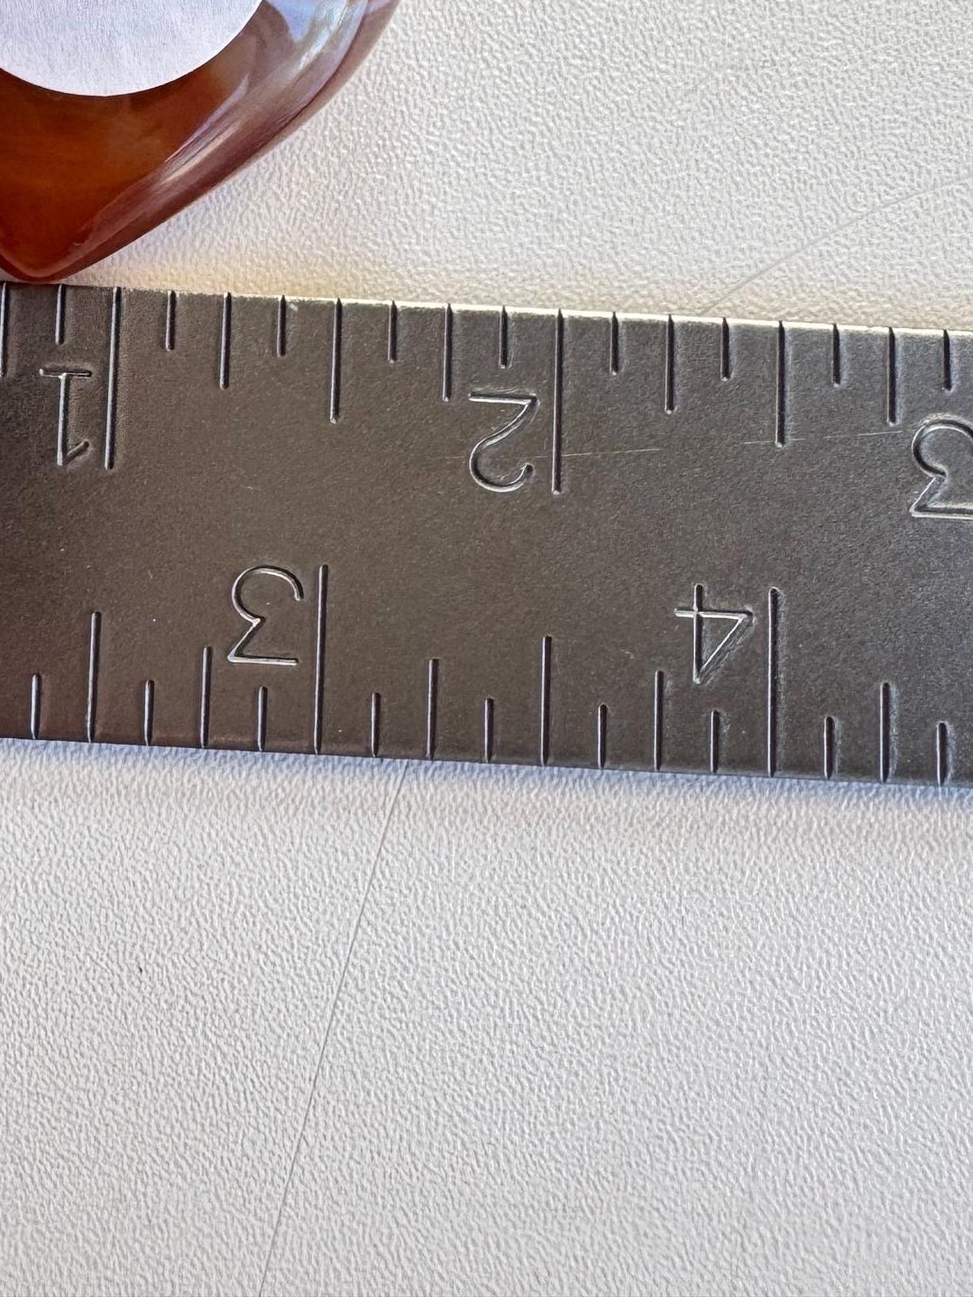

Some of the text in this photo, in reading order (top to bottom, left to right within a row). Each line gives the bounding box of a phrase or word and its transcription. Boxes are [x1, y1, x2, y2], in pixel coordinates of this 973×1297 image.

[37, 362, 93, 468] 1
[467, 391, 539, 494] 2
[910, 414, 973, 521] 3
[226, 563, 306, 668] 3
[673, 583, 755, 686] 4
